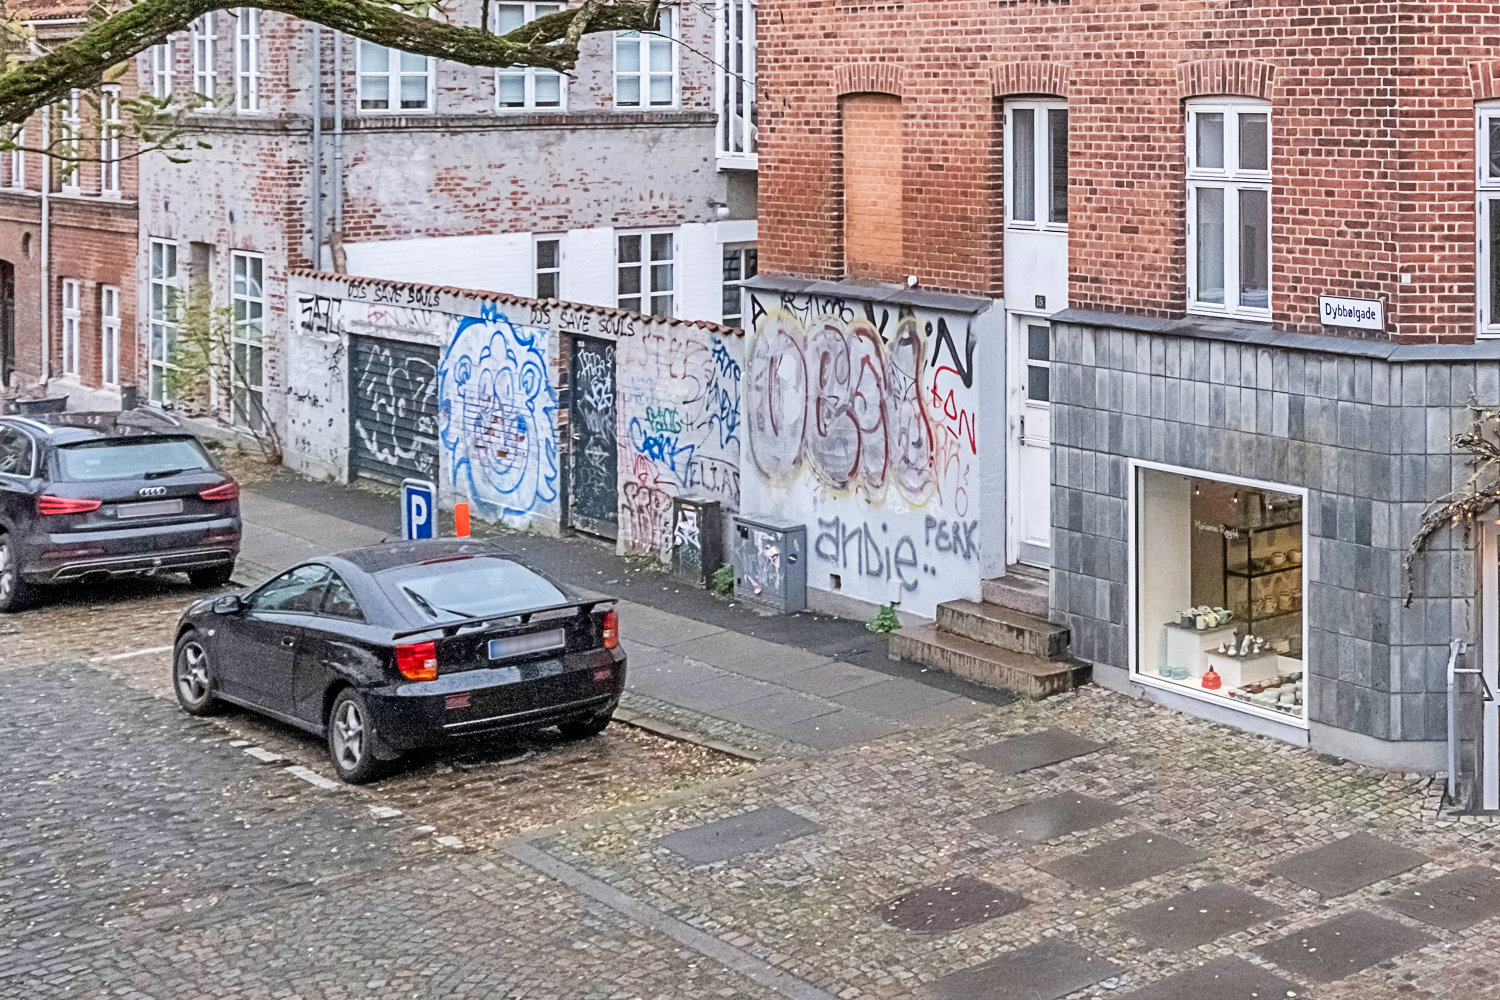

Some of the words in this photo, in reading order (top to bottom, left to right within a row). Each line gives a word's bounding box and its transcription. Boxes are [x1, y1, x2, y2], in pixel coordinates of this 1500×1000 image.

[406, 286, 440, 308] SOULS
[558, 311, 591, 332] SAVE
[598, 317, 635, 337] SOULS
[1325, 302, 1376, 322] Dybbølgade
[411, 494, 427, 540] P
[924, 514, 980, 561] PERK
